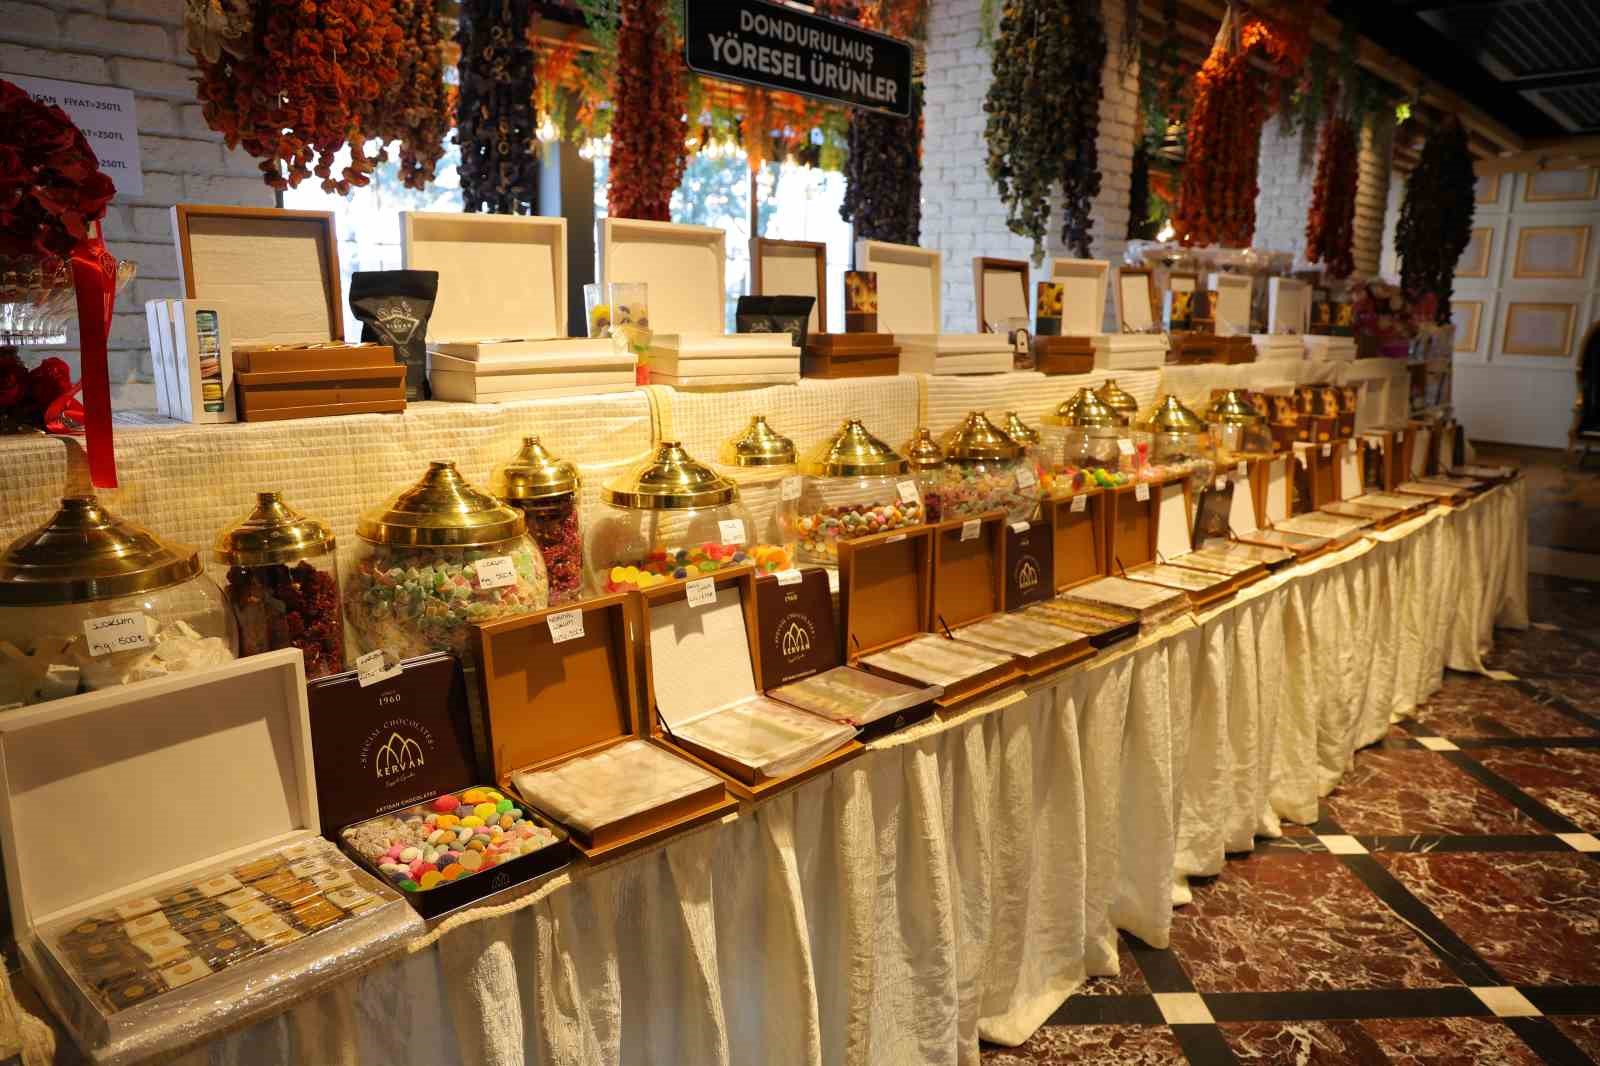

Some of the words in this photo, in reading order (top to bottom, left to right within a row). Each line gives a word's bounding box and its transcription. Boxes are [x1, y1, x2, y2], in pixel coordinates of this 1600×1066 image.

[740, 9, 875, 70] DONDURULMUŞ
[708, 31, 806, 82] YÖRESEL
[811, 53, 897, 103] ÜRÜNLER
[378, 694, 401, 706] 1960
[376, 757, 425, 779] KERVAN
